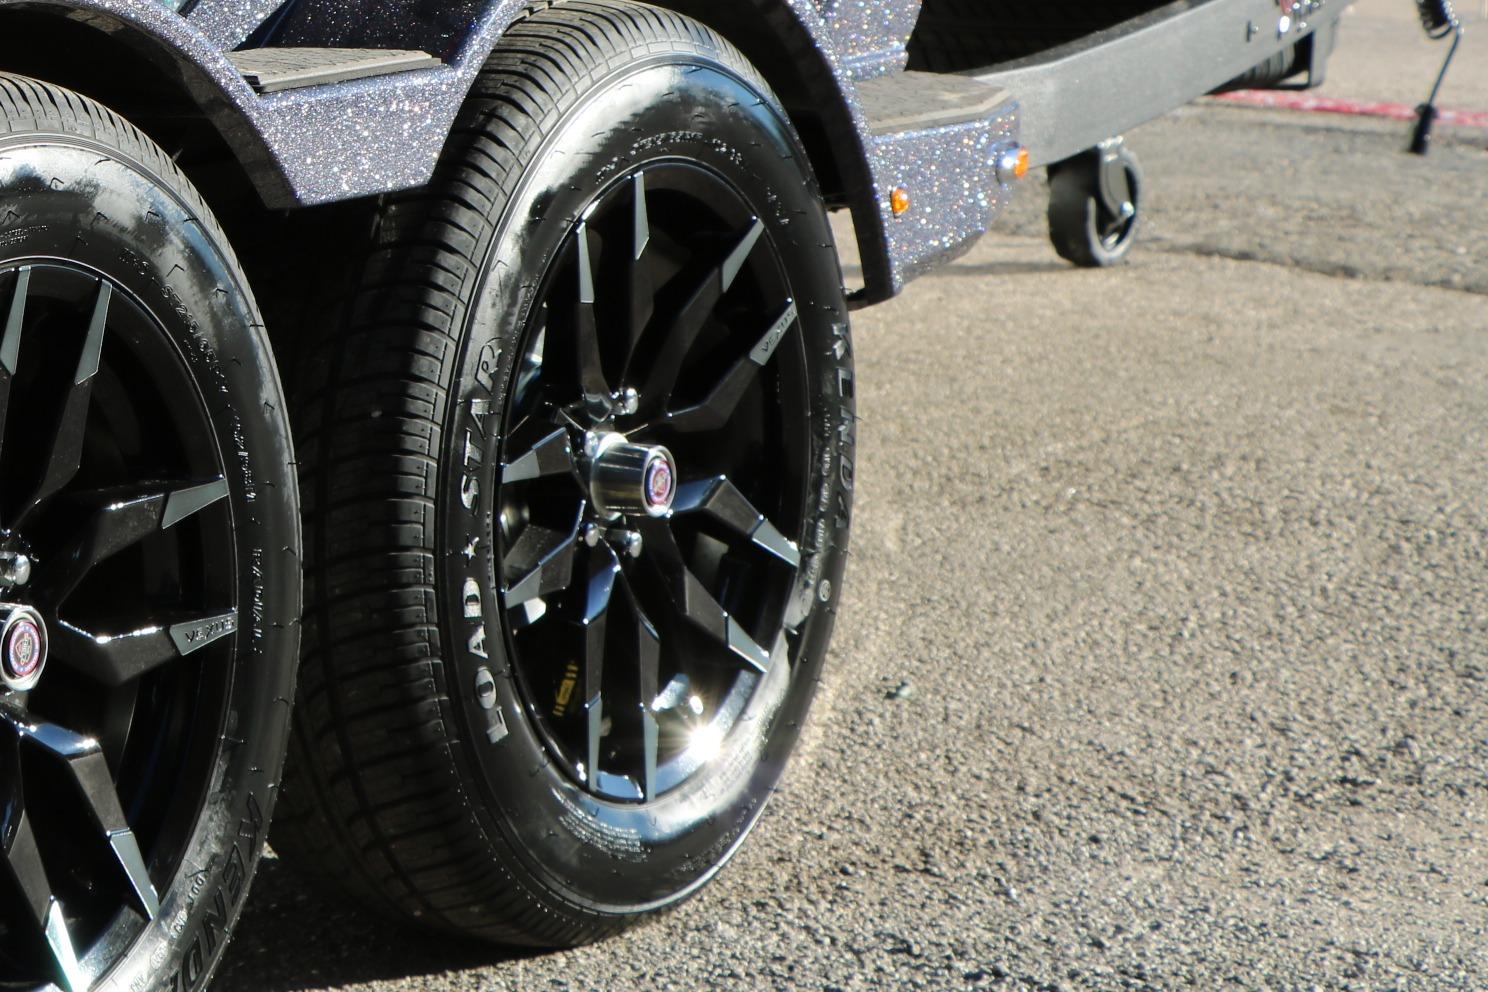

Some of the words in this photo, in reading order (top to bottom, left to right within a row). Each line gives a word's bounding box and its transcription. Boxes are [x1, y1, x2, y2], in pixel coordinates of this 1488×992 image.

[461, 337, 502, 516] STAR
[832, 322, 854, 530] KENDA
[463, 577, 509, 744] LOAD
